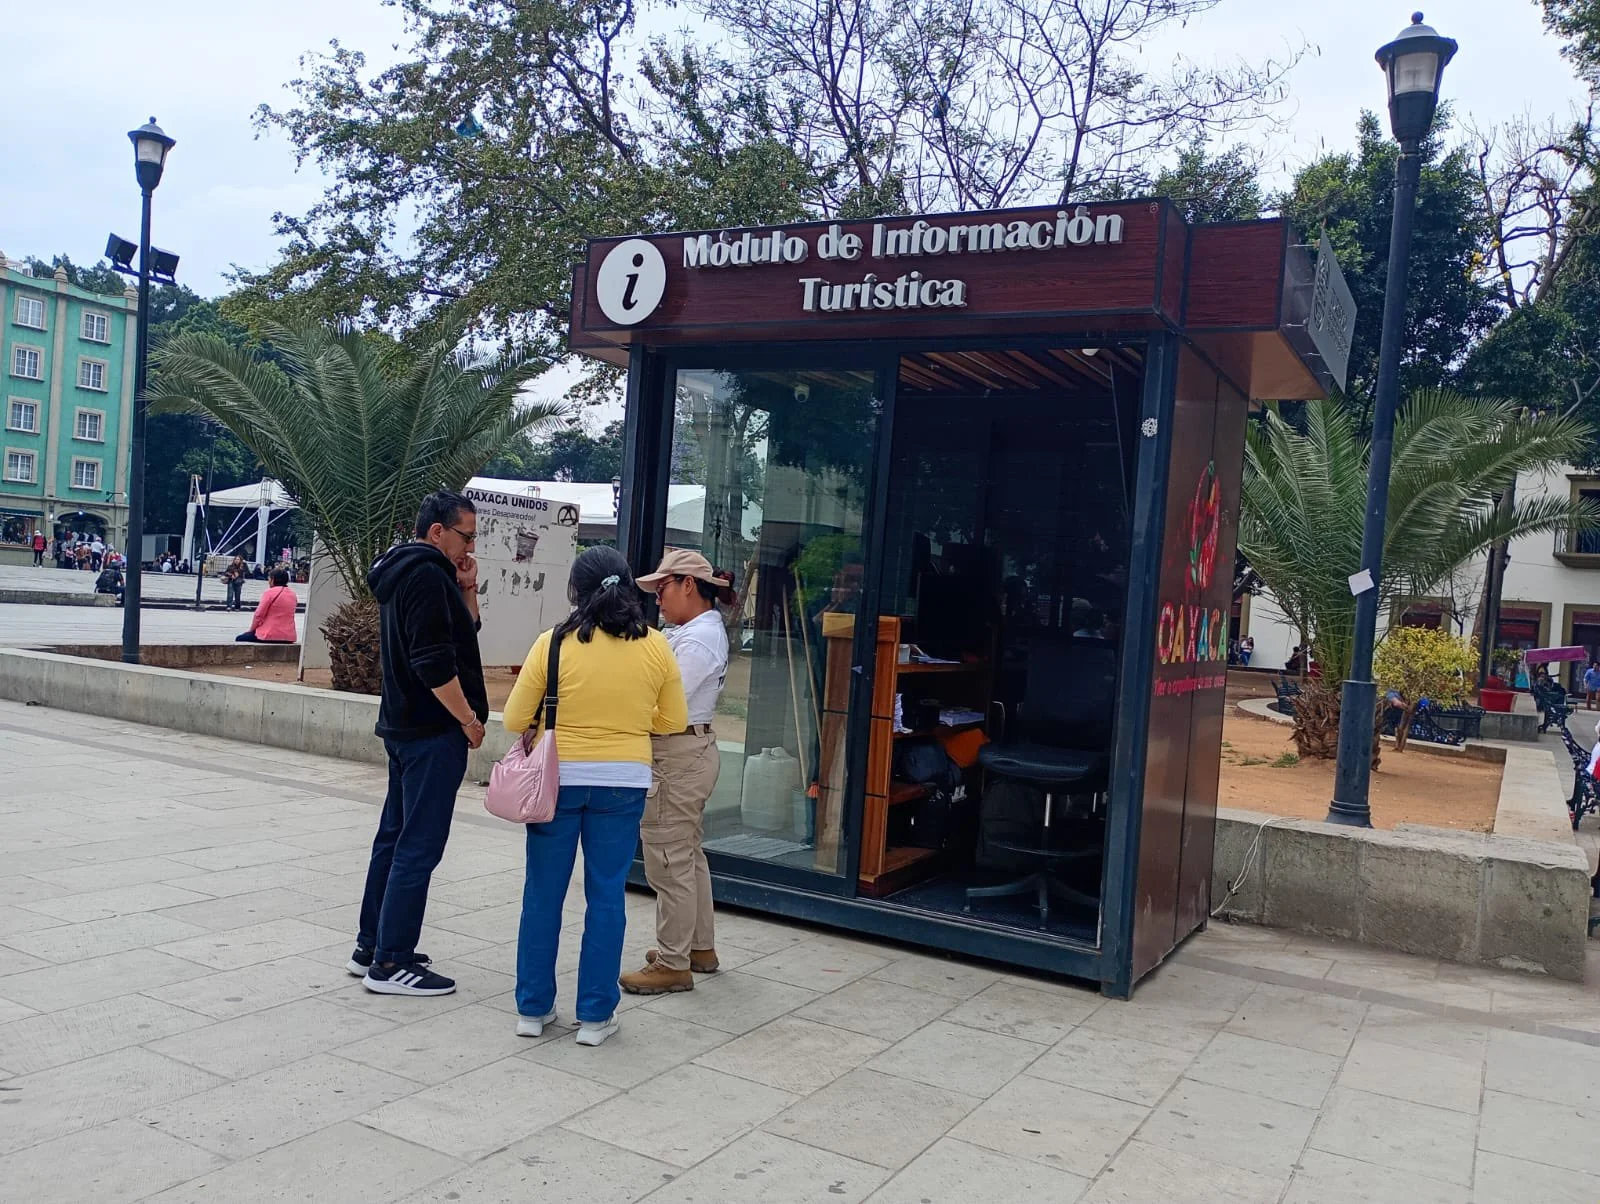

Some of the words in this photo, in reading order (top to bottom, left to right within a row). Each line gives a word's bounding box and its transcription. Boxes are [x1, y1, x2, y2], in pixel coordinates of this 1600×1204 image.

[683, 231, 808, 268] Módulo
[817, 224, 863, 260] de
[871, 206, 1124, 257] Información
[799, 270, 967, 311] Turística
[466, 490, 508, 506] OAXACA
[511, 497, 548, 511] UNIDOS
[1158, 602, 1227, 664] OAXACA
